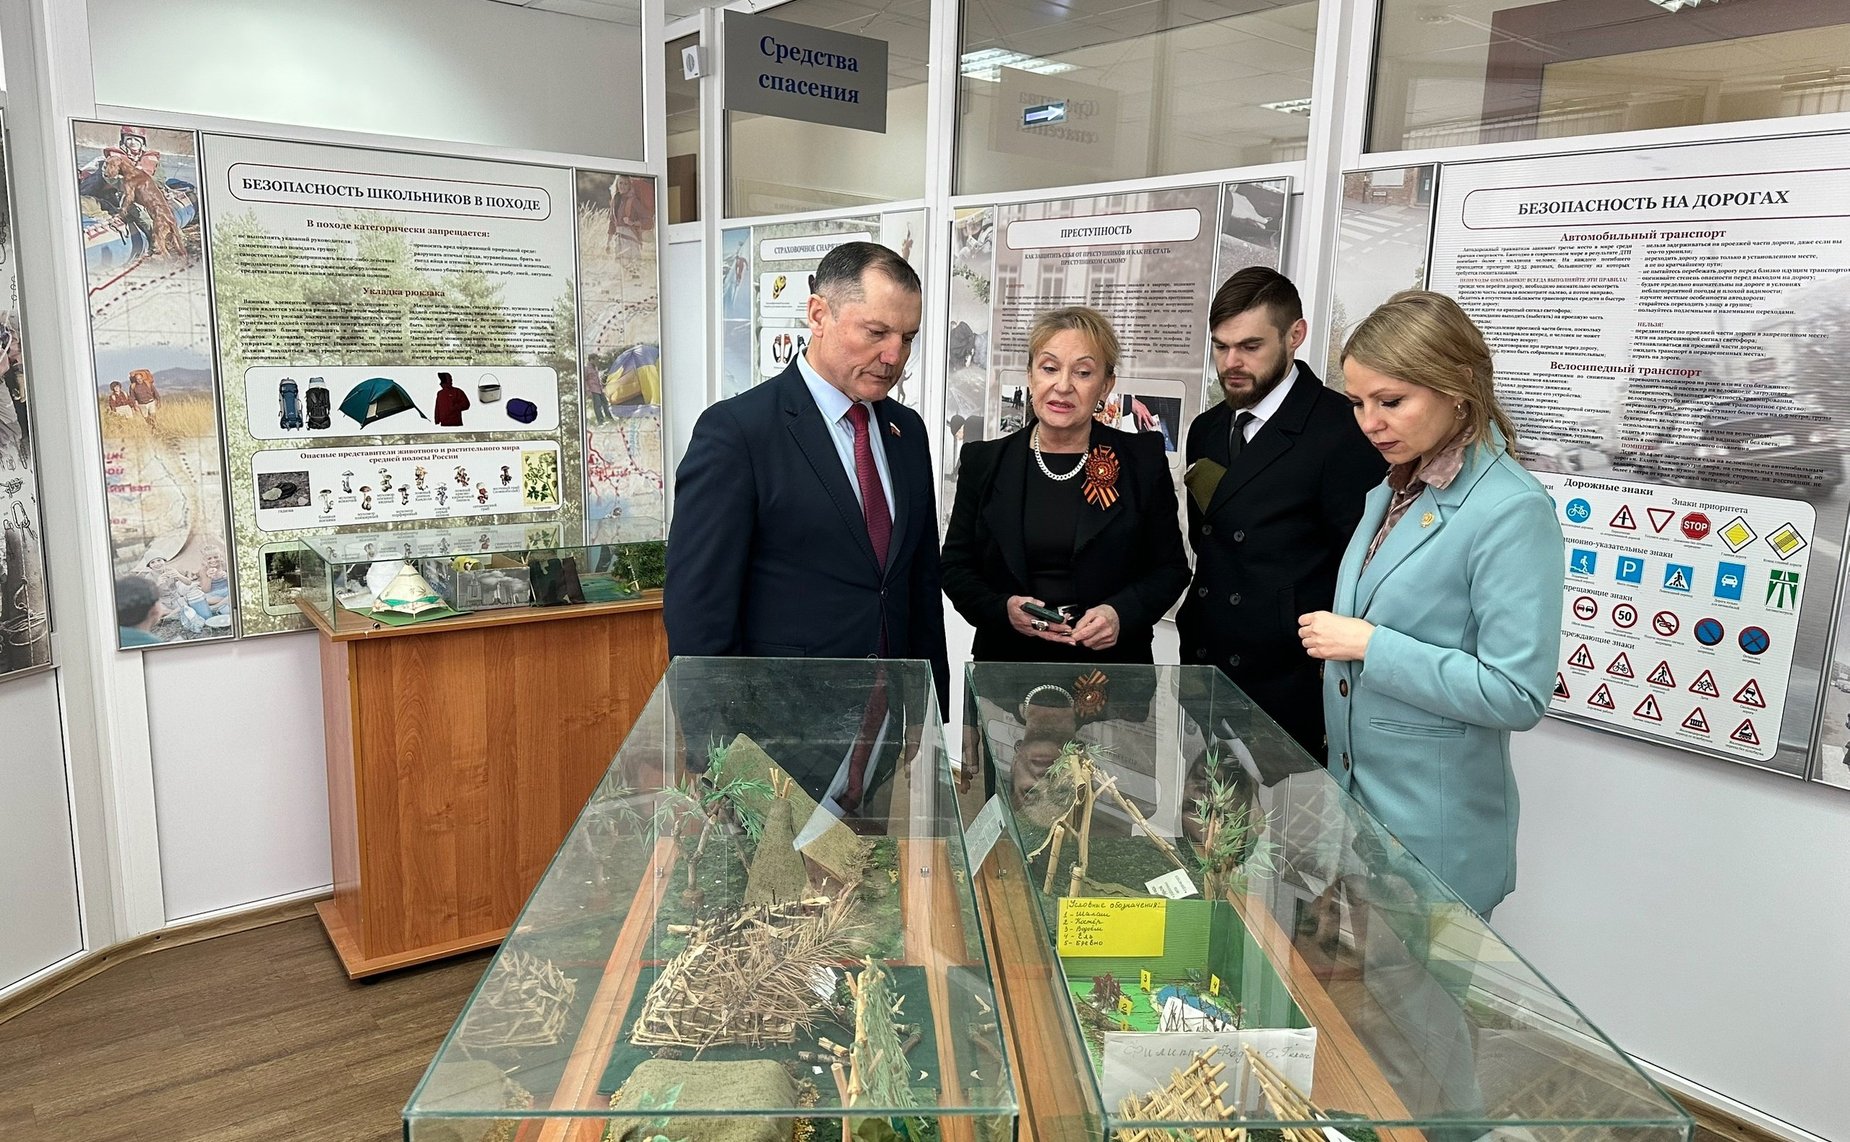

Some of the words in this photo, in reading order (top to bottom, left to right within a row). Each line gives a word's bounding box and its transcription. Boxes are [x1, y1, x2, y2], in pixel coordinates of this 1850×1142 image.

[760, 36, 859, 72] Средства
[758, 74, 859, 104] спасения
[242, 178, 364, 198] БЕЗОПАСНОСТЬ
[367, 187, 472, 206] ШКОЛЬНИКОВ
[475, 196, 483, 206] В
[486, 196, 540, 211] ПОХОДЕ
[1518, 197, 1658, 214] БЕЗОПАСНОСТЬ
[1664, 196, 1688, 208] НА
[1694, 191, 1789, 209] ДОРОГАХ
[307, 219, 314, 228] В
[317, 222, 352, 231] походе
[354, 224, 424, 234] категорически
[427, 227, 490, 237] запрещается:
[1060, 225, 1133, 237] ПРЕСТУПНОСТЬ
[1560, 230, 1657, 241] Автомобильный
[1660, 231, 1726, 241] транспорт
[774, 244, 815, 255] СТРАХОВОЧНОЕ
[362, 288, 403, 297] Укладка
[1550, 361, 1635, 374] Велосипедный
[1638, 367, 1702, 377] транспорт
[338, 450, 395, 458] представители
[446, 447, 500, 455] растительного
[369, 455, 400, 464] средней
[1564, 479, 1619, 493] Дорожные
[1622, 486, 1653, 495] знаки
[1672, 499, 1697, 508] Знаки
[1699, 503, 1748, 514] приоритета
[1683, 520, 1707, 531] STOP
[1622, 561, 1636, 577] P
[1618, 611, 1632, 621] 50
[1143, 974, 1148, 982] 3
